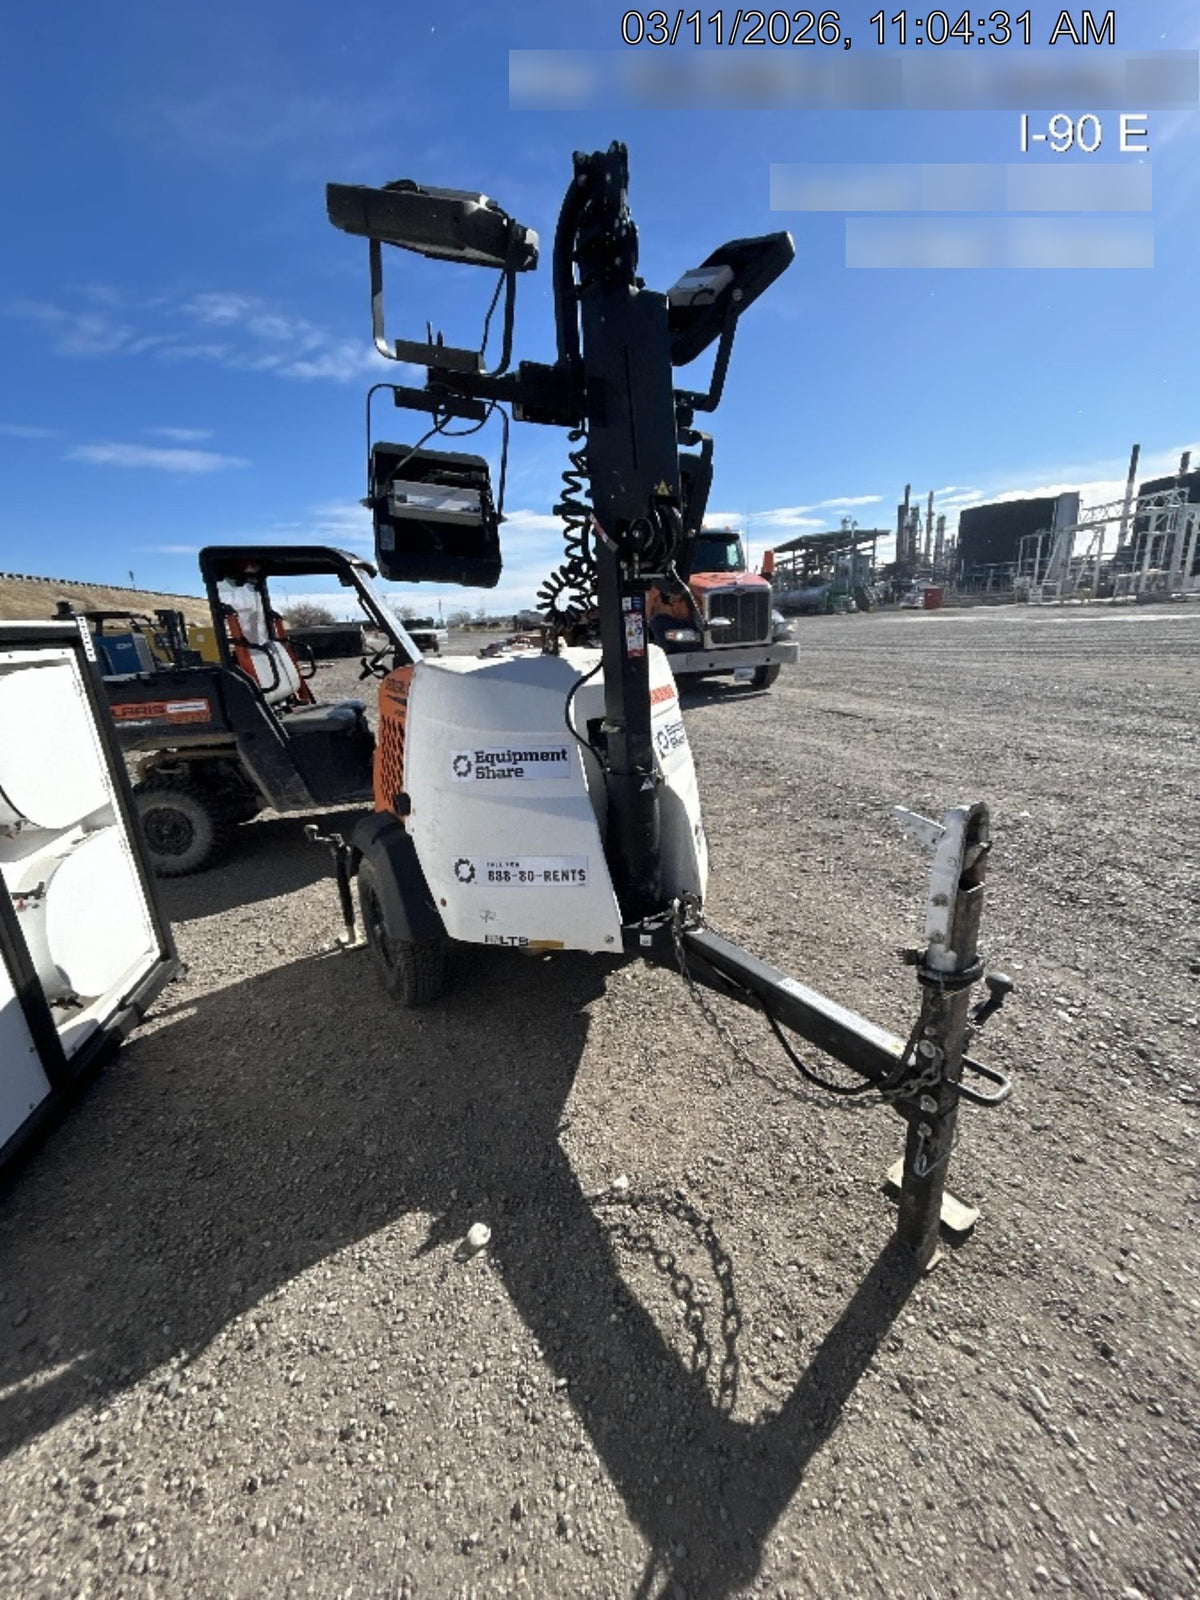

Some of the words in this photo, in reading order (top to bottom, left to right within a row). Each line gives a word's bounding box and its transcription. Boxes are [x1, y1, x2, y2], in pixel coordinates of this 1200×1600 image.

[112, 705, 166, 717] LARIS
[474, 749, 568, 767] Equipment
[475, 766, 524, 780] Share
[487, 869, 587, 882] 888-80-RENTS
